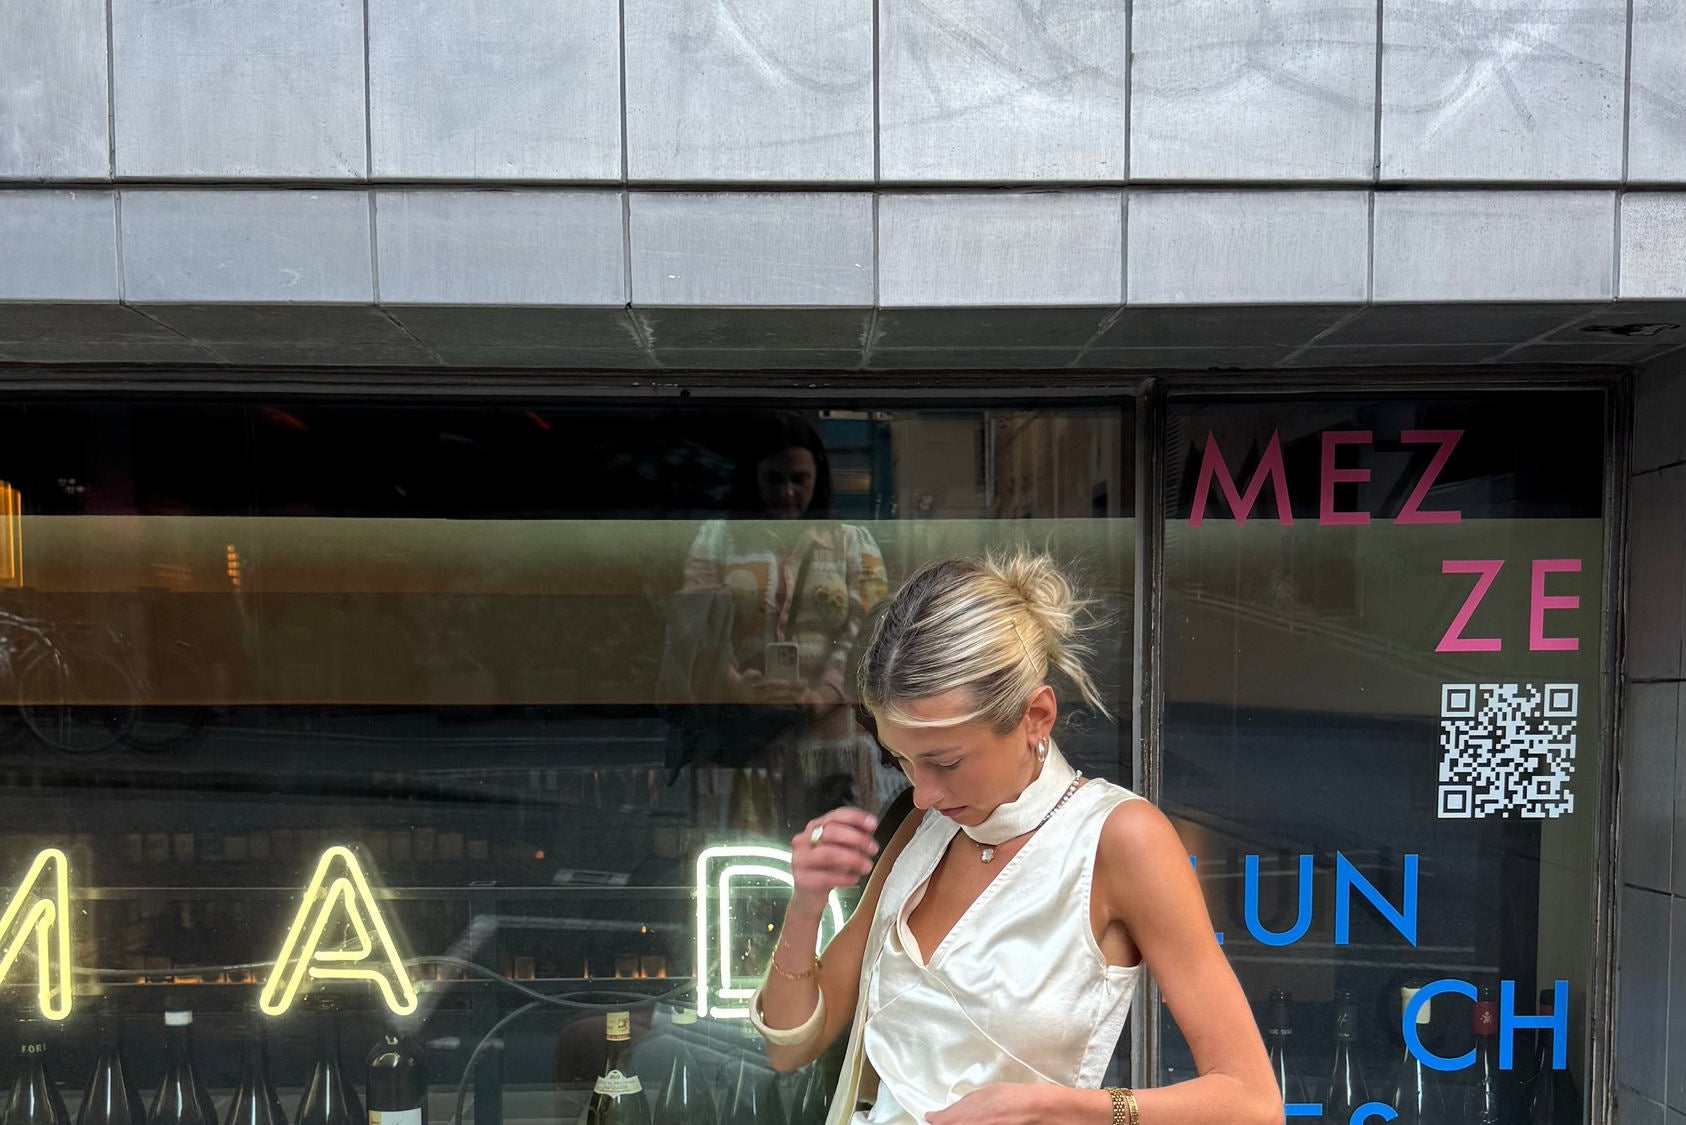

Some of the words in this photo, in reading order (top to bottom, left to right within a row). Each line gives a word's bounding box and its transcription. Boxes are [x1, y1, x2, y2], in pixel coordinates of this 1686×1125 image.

[1188, 428, 1466, 527] MEZ
[1435, 558, 1582, 652] ZE
[1188, 850, 1419, 948] UN
[1402, 979, 1569, 1072] CH
